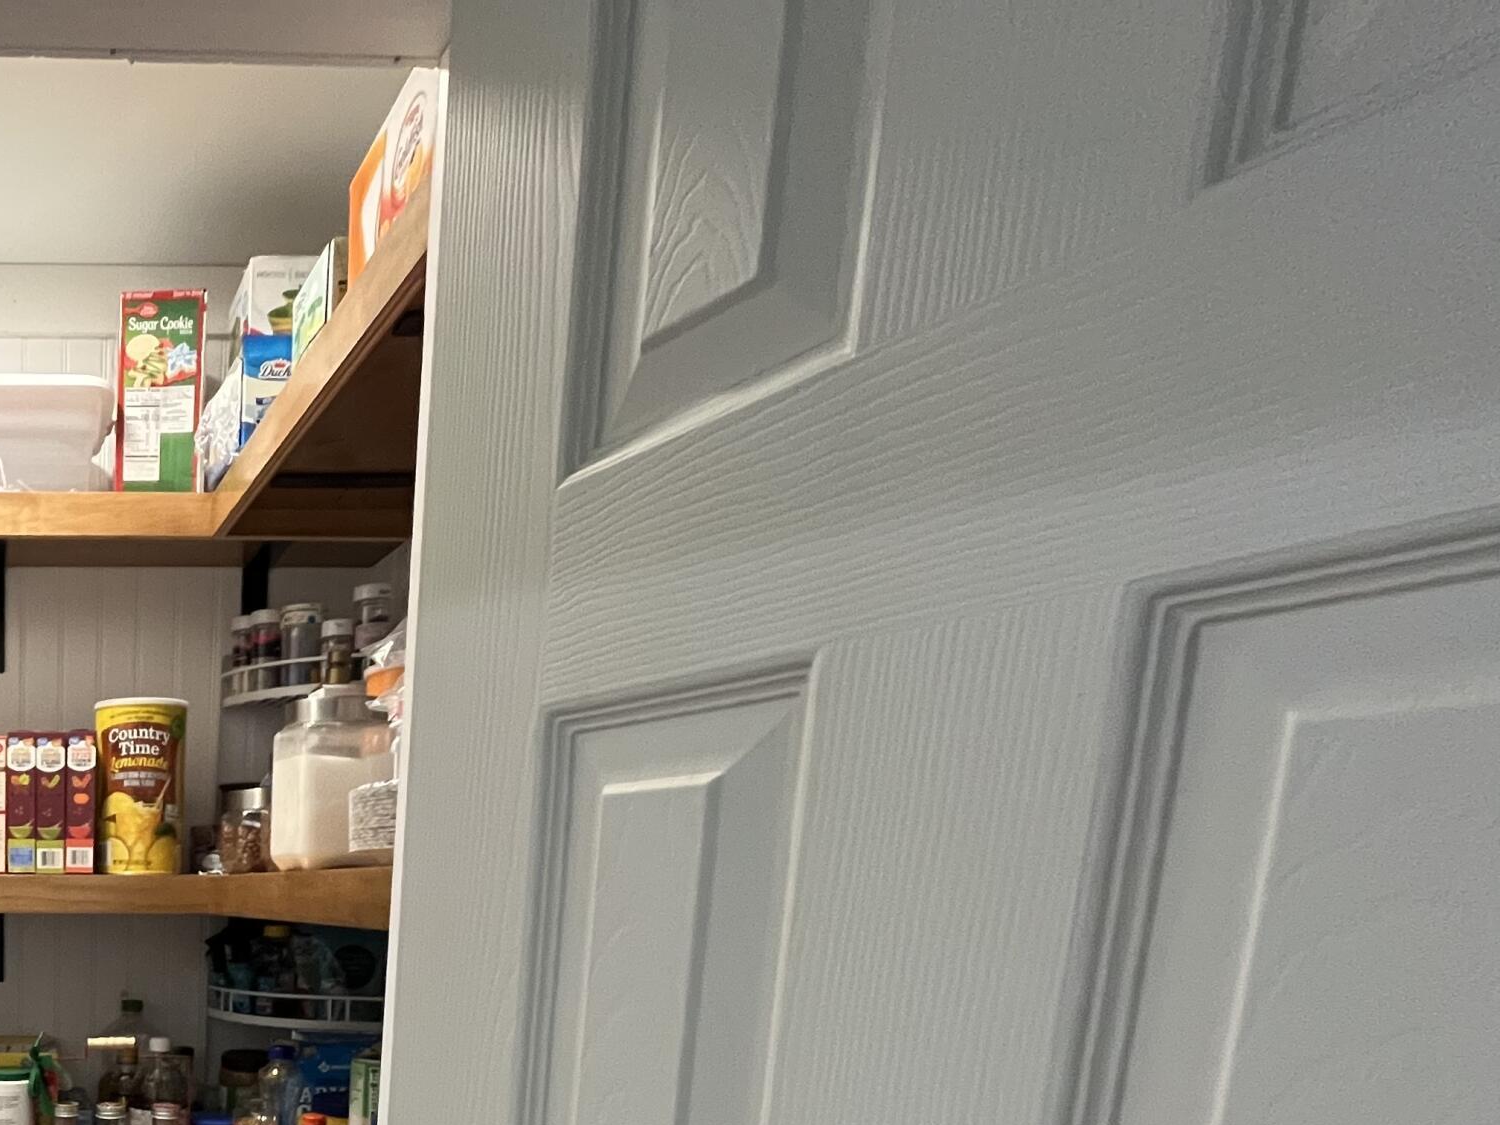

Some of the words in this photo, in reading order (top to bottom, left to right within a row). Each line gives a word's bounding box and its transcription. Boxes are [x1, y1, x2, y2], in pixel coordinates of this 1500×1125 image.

[128, 316, 159, 334] Sugar
[160, 315, 194, 335] Cookie
[108, 726, 171, 746] Country
[118, 740, 160, 756] Time
[110, 756, 169, 773] Lemonade
